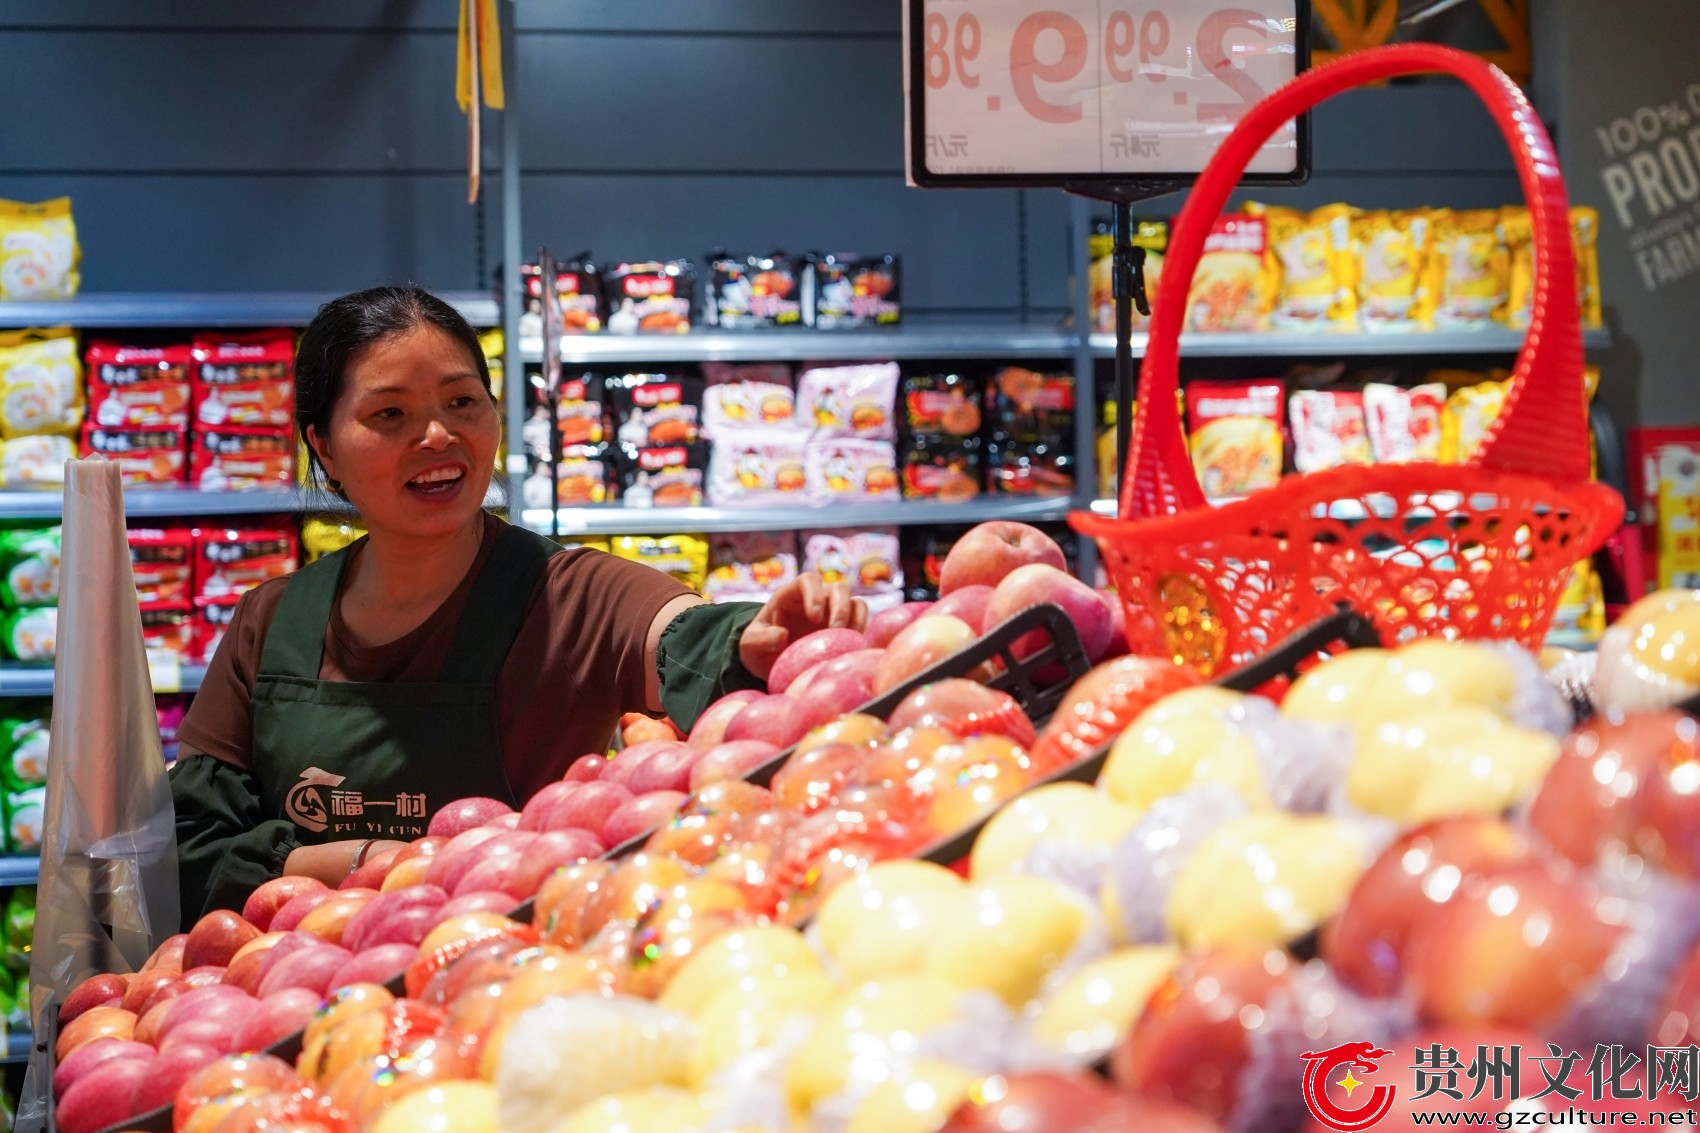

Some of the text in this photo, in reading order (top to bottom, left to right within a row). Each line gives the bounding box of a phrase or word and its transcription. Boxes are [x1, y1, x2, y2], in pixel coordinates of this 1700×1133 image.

[331, 791, 427, 817] 福一村
[335, 823, 356, 833] FU
[367, 822, 382, 833] YI
